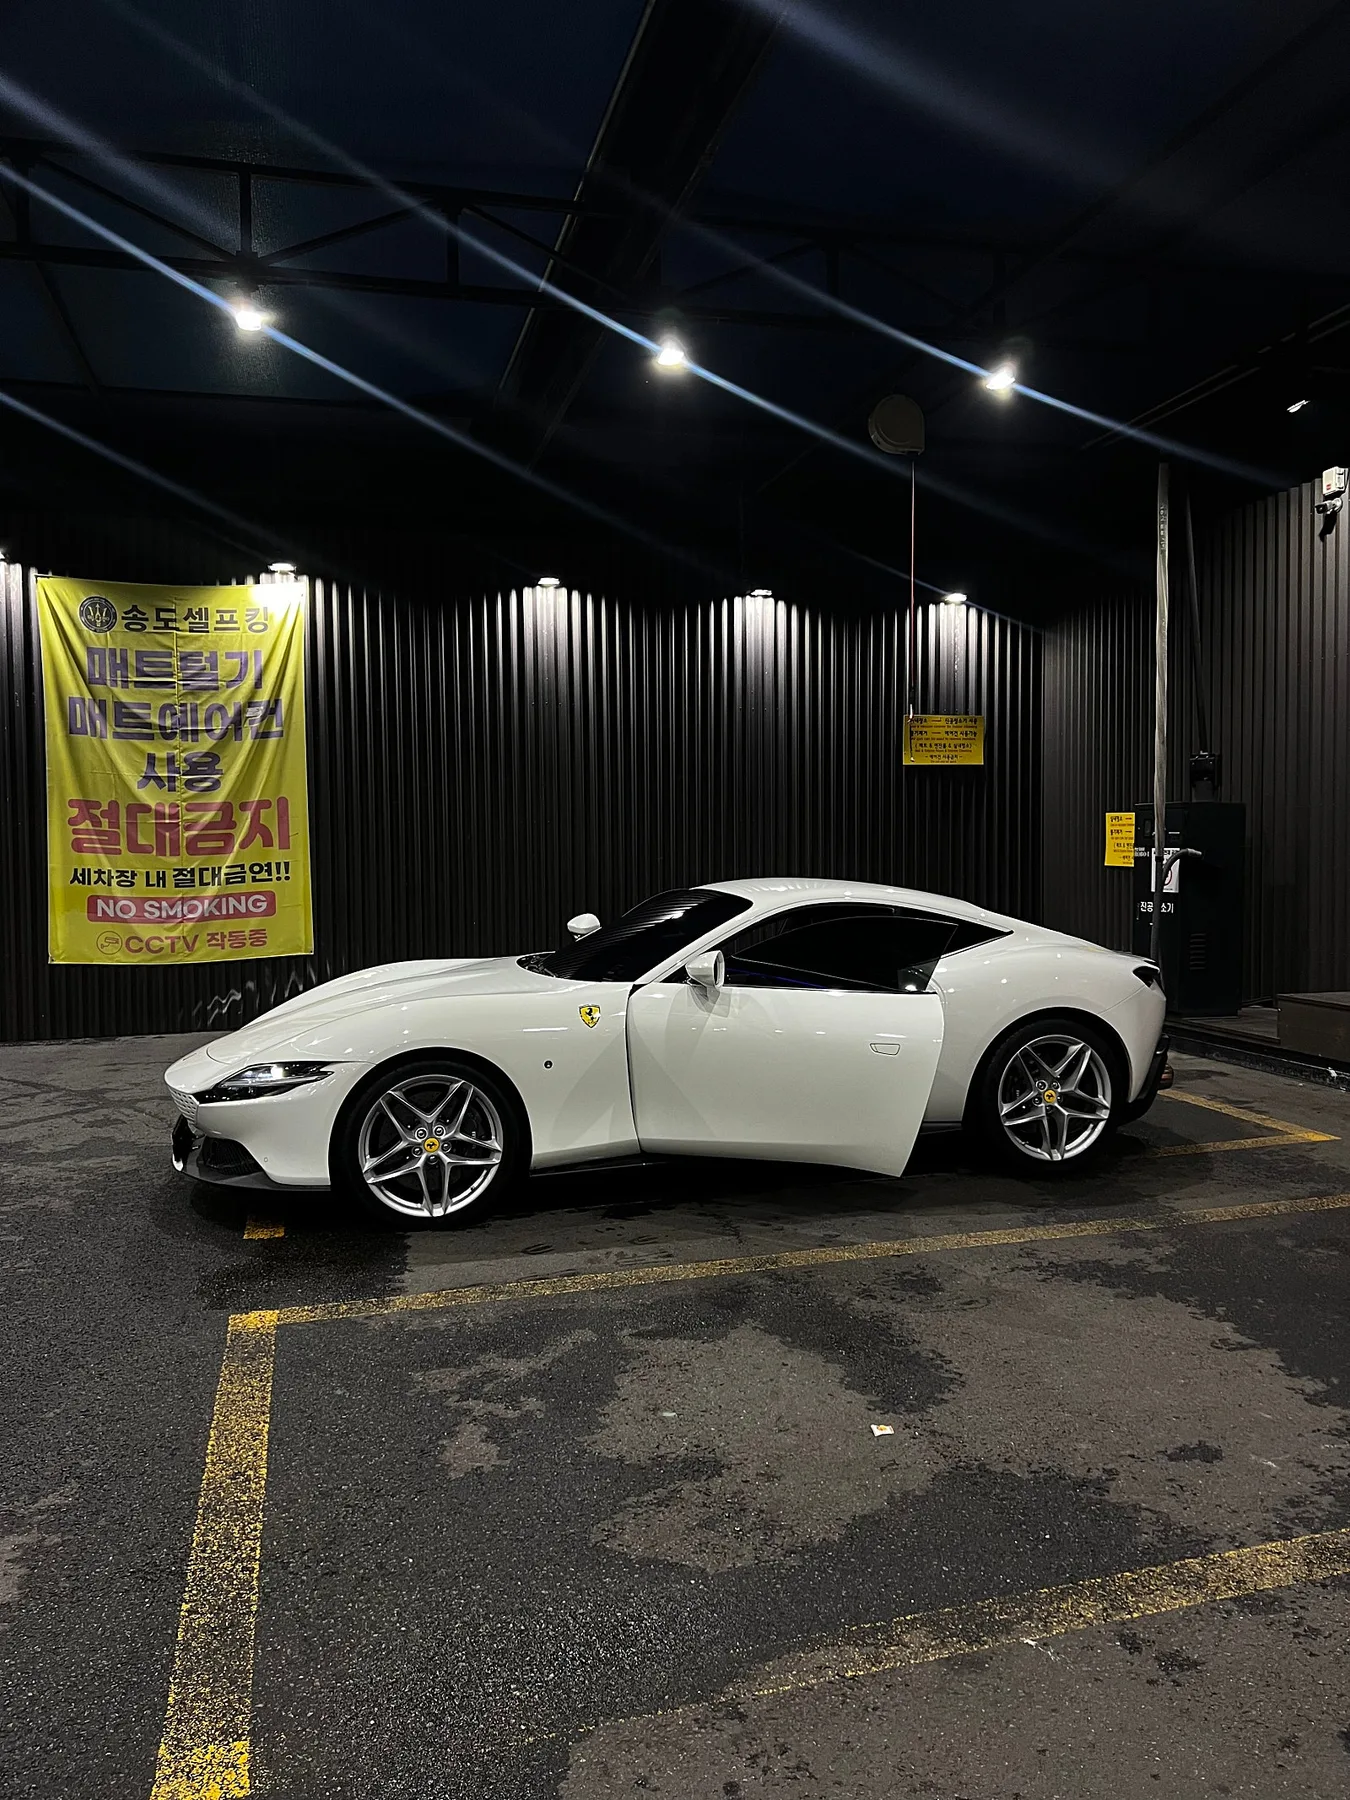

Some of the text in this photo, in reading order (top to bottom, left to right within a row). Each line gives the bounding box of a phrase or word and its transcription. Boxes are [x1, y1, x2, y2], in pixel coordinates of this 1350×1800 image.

[121, 604, 269, 633] 송도셀프킹
[86, 646, 263, 691] 매트털기
[137, 751, 223, 792] 사용
[67, 796, 291, 857] 절대금지
[70, 861, 291, 888] 세차장 내 절대금연!!
[96, 894, 268, 919] NO SMOKING
[1140, 901, 1174, 913] 진공소기
[125, 928, 268, 954] CCTV 작동중
